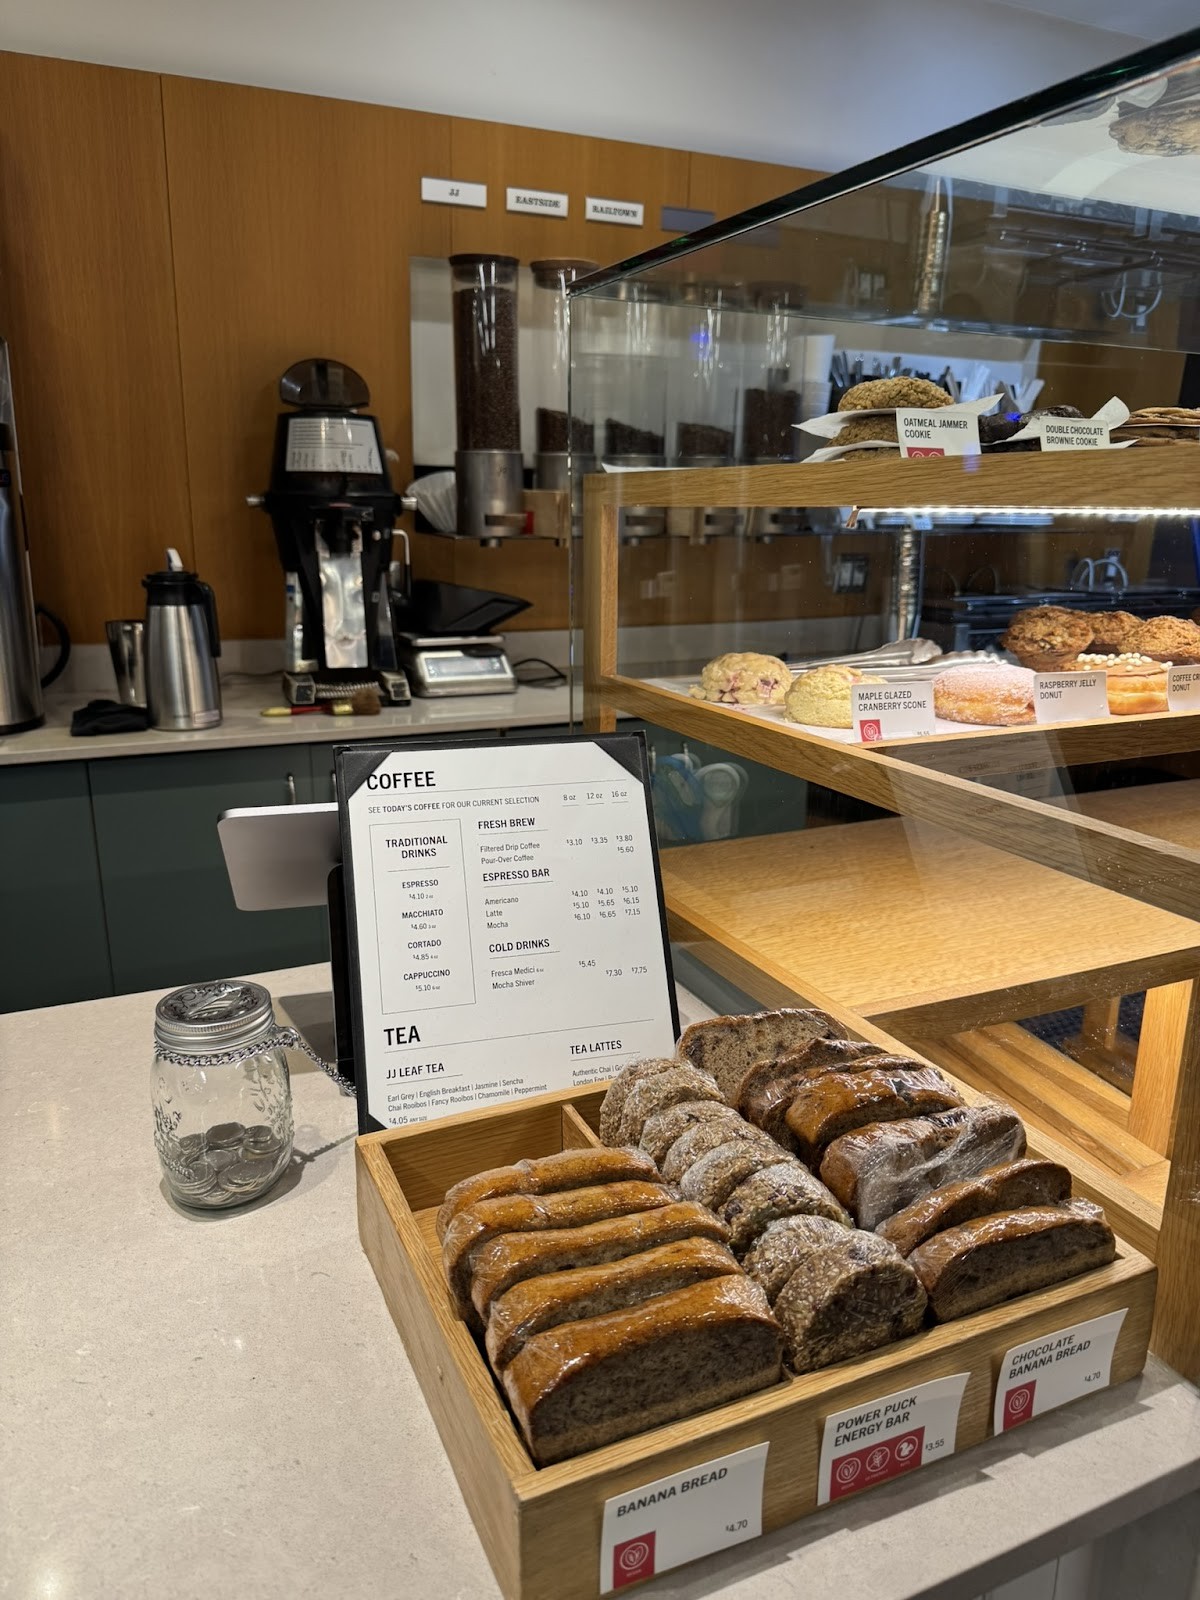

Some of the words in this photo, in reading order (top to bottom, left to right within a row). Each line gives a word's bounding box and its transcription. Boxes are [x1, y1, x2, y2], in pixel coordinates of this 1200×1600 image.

[515, 196, 561, 208] EASTSIDE
[592, 205, 638, 218] RAILTOWN
[904, 418, 937, 428] OATMEAL
[938, 419, 968, 429] JAMMER
[904, 430, 931, 439] COOKIE
[1046, 425, 1069, 434] DOUBLE
[1070, 426, 1104, 435] CHOCOLATE
[1046, 436, 1075, 445] BROWNIE
[1076, 437, 1098, 446] COOKIE
[1172, 674, 1191, 682] COFFEE
[1040, 680, 1078, 690] RASPBERRY
[1079, 679, 1097, 688] JELLY
[1172, 684, 1190, 692] DONUT
[858, 692, 882, 701] MAPLE
[884, 691, 912, 700] GLAZED
[1040, 691, 1063, 699] DONUT
[858, 702, 901, 711] CRANBERRY
[903, 700, 927, 709] SCONE
[367, 771, 436, 790] COFFEE
[368, 806, 381, 814] SEE
[383, 804, 412, 813] TODAY'S
[414, 802, 440, 811] COFFEE
[442, 801, 456, 809] FOR
[456, 800, 471, 808] OUR
[472, 798, 503, 807] CURRENT
[504, 796, 540, 805] SELECTION
[478, 819, 507, 830] FRESH
[509, 817, 535, 828] BREW
[385, 835, 448, 848] TRADITIONAL
[566, 838, 583, 846] $3.10
[591, 836, 608, 844] $3.35
[616, 834, 633, 842] $3.80
[480, 844, 504, 853] Filtered
[505, 844, 519, 852] Drip
[520, 842, 540, 850] Coffee
[401, 848, 437, 859] DRINKS
[481, 856, 512, 864] Pour-Over
[513, 854, 534, 862] Coffee
[482, 869, 530, 882] ESPRESSO
[531, 868, 550, 878] BAR
[402, 879, 439, 889] ESPRESSO
[597, 887, 613, 895] $4.10
[622, 885, 639, 893] $5.10
[409, 892, 425, 900] $4.10
[485, 897, 519, 905] Americano
[573, 901, 590, 909] $5.10
[598, 899, 615, 907] $5.65
[402, 908, 444, 919] MACCHIATO
[574, 913, 591, 921] $6.10
[599, 910, 616, 918] $6.65
[624, 908, 641, 916] $7.15
[487, 921, 509, 929] Mocha
[407, 939, 442, 949] CORTADO
[488, 942, 513, 953] COLD
[516, 938, 550, 950] DRINKS
[578, 960, 596, 968] $5.45
[403, 969, 451, 981] CAPPUCCINO
[491, 968, 513, 977] Fresca
[514, 966, 535, 975] Medici
[606, 969, 623, 977] $7.30
[631, 966, 648, 974] $7.75
[415, 984, 431, 992] $5.10
[492, 981, 514, 989] Mocha
[515, 979, 535, 987] Shiver
[383, 1025, 421, 1046] TEA
[570, 1044, 587, 1055] TEA
[589, 1040, 622, 1052] LATTES
[386, 1069, 396, 1079] JJ
[399, 1065, 423, 1078] LEAF
[425, 1062, 445, 1073] TEA
[572, 1068, 598, 1077] Authentic
[573, 1077, 593, 1086] London
[387, 1094, 399, 1102] Earl
[400, 1093, 415, 1101] Grey
[419, 1089, 440, 1098] English
[441, 1084, 470, 1095] Breakfast
[475, 1081, 498, 1090] Jasmine
[502, 1078, 524, 1086] Sencha
[388, 1103, 402, 1112] Chai
[403, 1101, 427, 1110] Rooibos
[431, 1098, 449, 1107] Fancy
[450, 1094, 474, 1103] Rooibos
[478, 1089, 510, 1099] Chamomile
[514, 1084, 547, 1095] Peppermint
[389, 1115, 408, 1125] $4.05
[1012, 1334, 1075, 1366] CHOCOLATE
[1009, 1355, 1053, 1379] BANANA
[1055, 1340, 1091, 1361] BREAD
[1084, 1371, 1101, 1382] $4.70
[836, 1409, 881, 1433] POWER
[884, 1395, 918, 1416] PUCK
[834, 1421, 883, 1447] ENERGY
[885, 1412, 910, 1429] BAR
[925, 1439, 944, 1451] $3.55
[617, 1486, 676, 1518] BANANA
[681, 1467, 728, 1493] BREAD
[725, 1519, 748, 1532] $4.70
